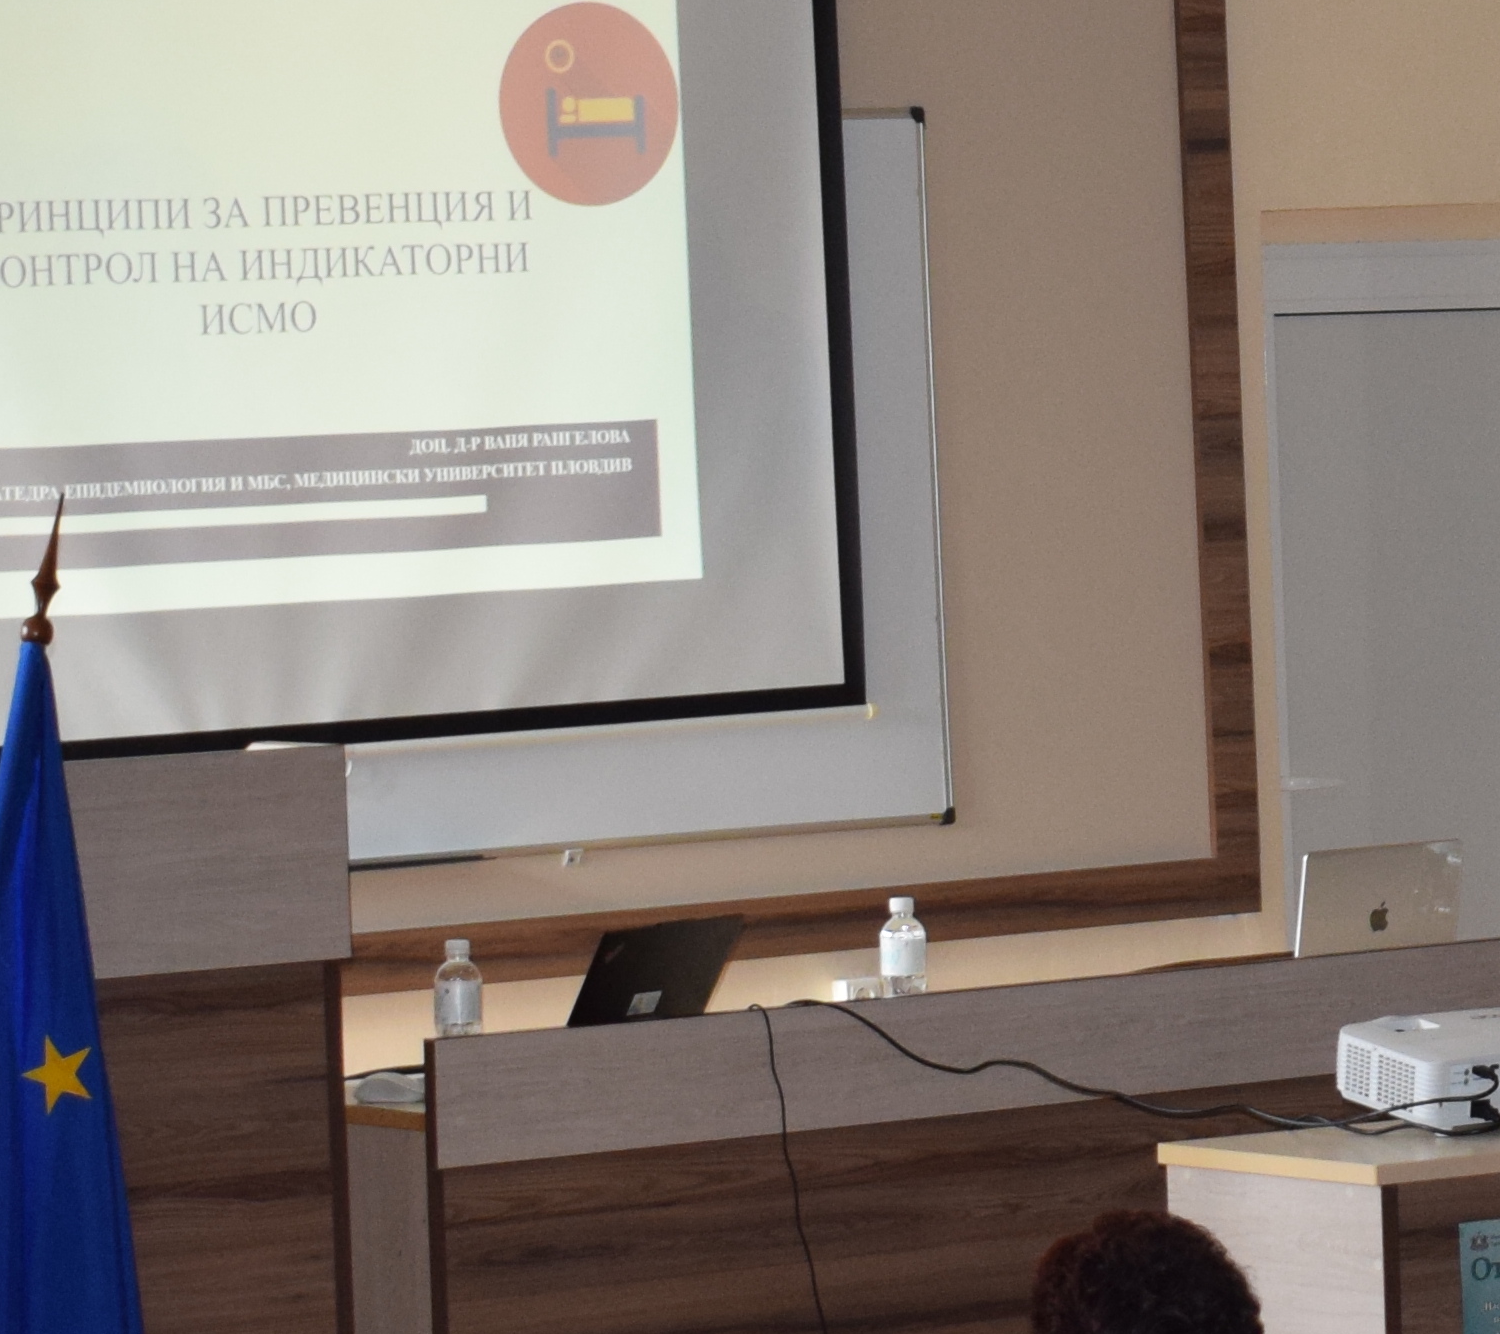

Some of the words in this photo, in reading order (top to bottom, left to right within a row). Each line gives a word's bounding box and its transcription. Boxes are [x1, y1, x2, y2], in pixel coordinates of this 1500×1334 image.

[203, 197, 251, 229] ЗА
[263, 191, 495, 229] ПРЕВЕНЦИЯ
[508, 190, 533, 221] И
[171, 251, 228, 283] НА
[240, 242, 530, 286] ИНДИКАТОРНИ
[199, 301, 317, 335] ИСМО
[454, 436, 481, 454] Д-Р
[64, 477, 227, 500] ЕПИДЕМИОЛОГИЯ
[230, 476, 243, 491] И
[248, 474, 291, 492] МБС,
[294, 469, 421, 489] МЕДИЦИНСКИ
[424, 462, 546, 484] УНИВЕРСИТЕТ
[551, 457, 633, 477] ПЛОВДИВ
